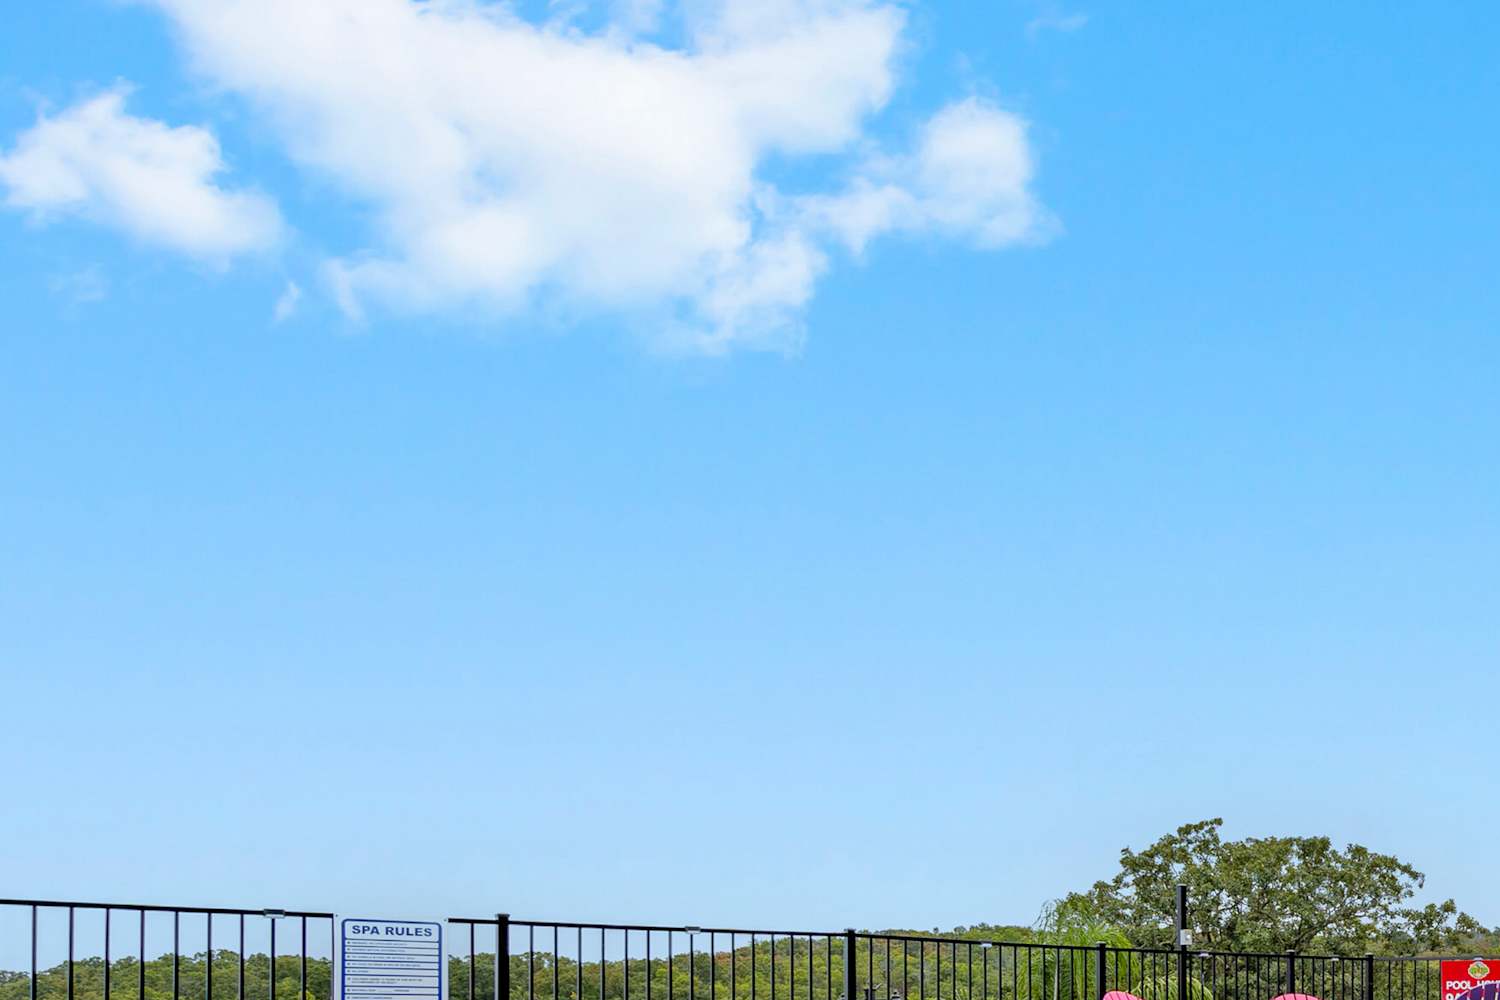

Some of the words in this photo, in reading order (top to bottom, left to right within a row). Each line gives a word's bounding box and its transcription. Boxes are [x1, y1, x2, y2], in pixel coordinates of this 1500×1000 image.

[352, 925, 380, 935] SPA
[385, 926, 433, 937] RULES
[1446, 980, 1472, 990] POOL
